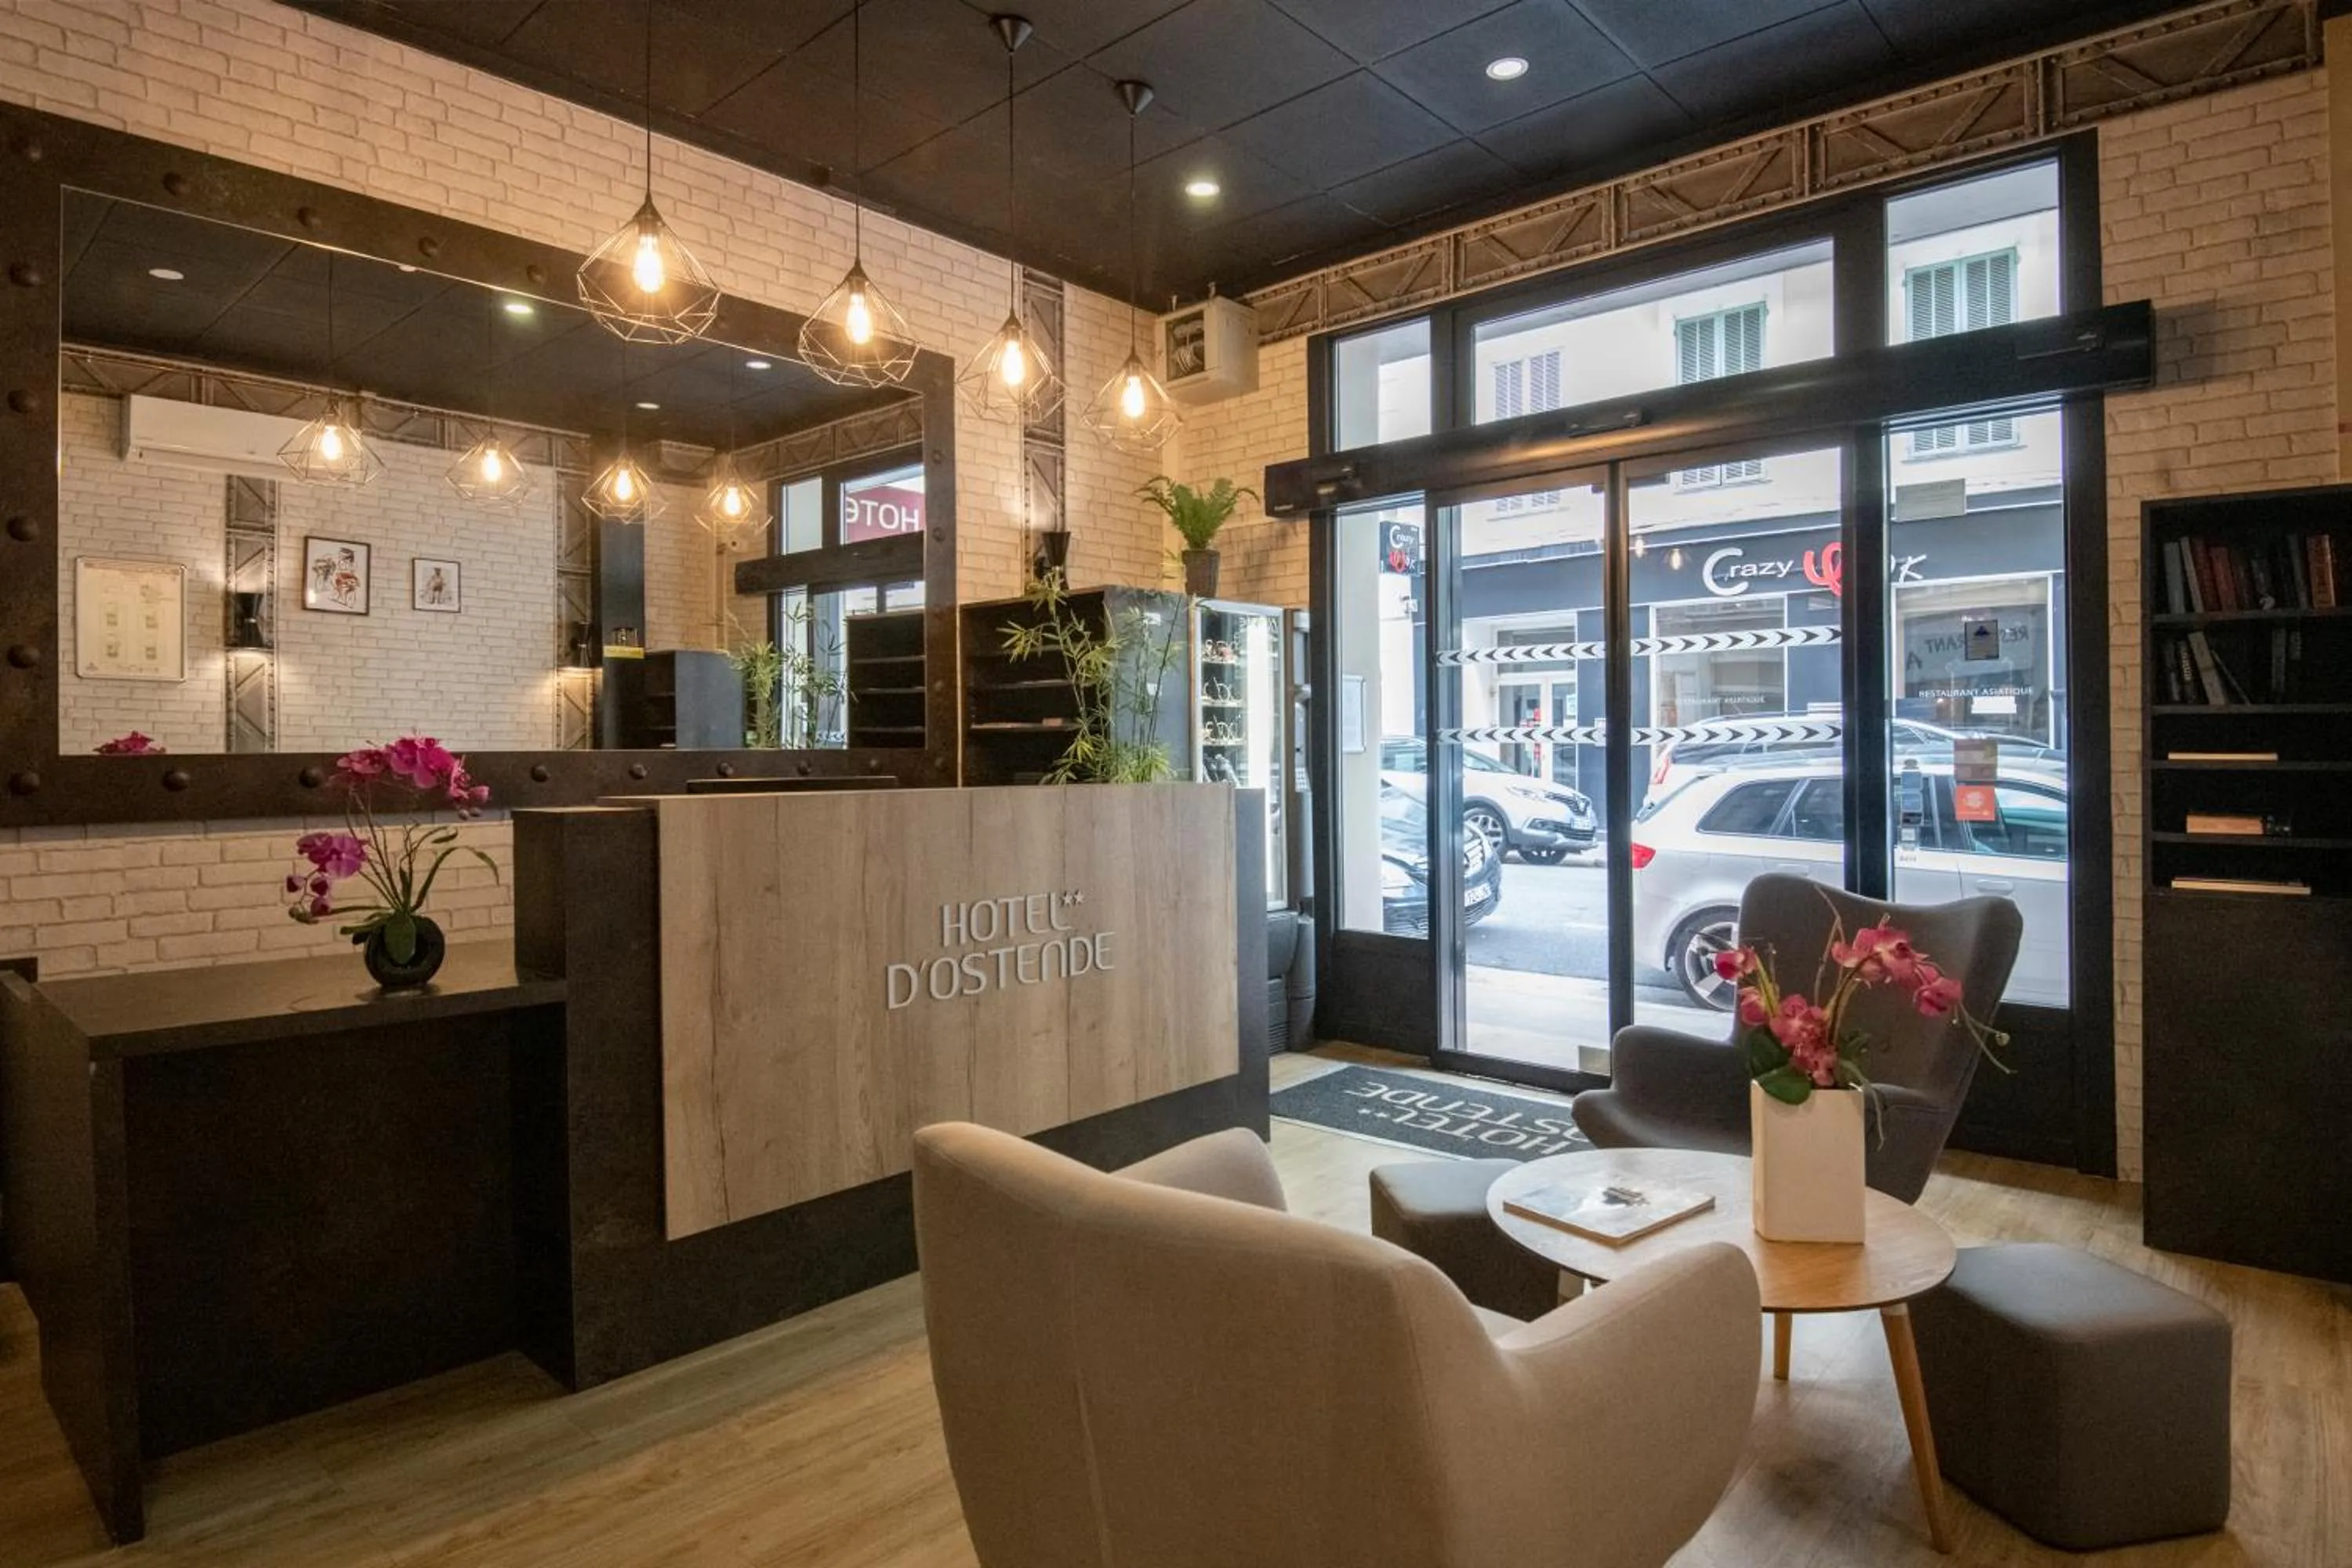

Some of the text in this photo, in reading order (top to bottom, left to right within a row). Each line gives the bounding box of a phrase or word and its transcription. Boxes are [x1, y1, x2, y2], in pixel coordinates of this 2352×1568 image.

[1702, 547, 1794, 596] Crazy
[942, 892, 1072, 947] HOTEL
[886, 931, 1116, 1010] D'OSTENDE
[1389, 1105, 1572, 1155] HOTEL
